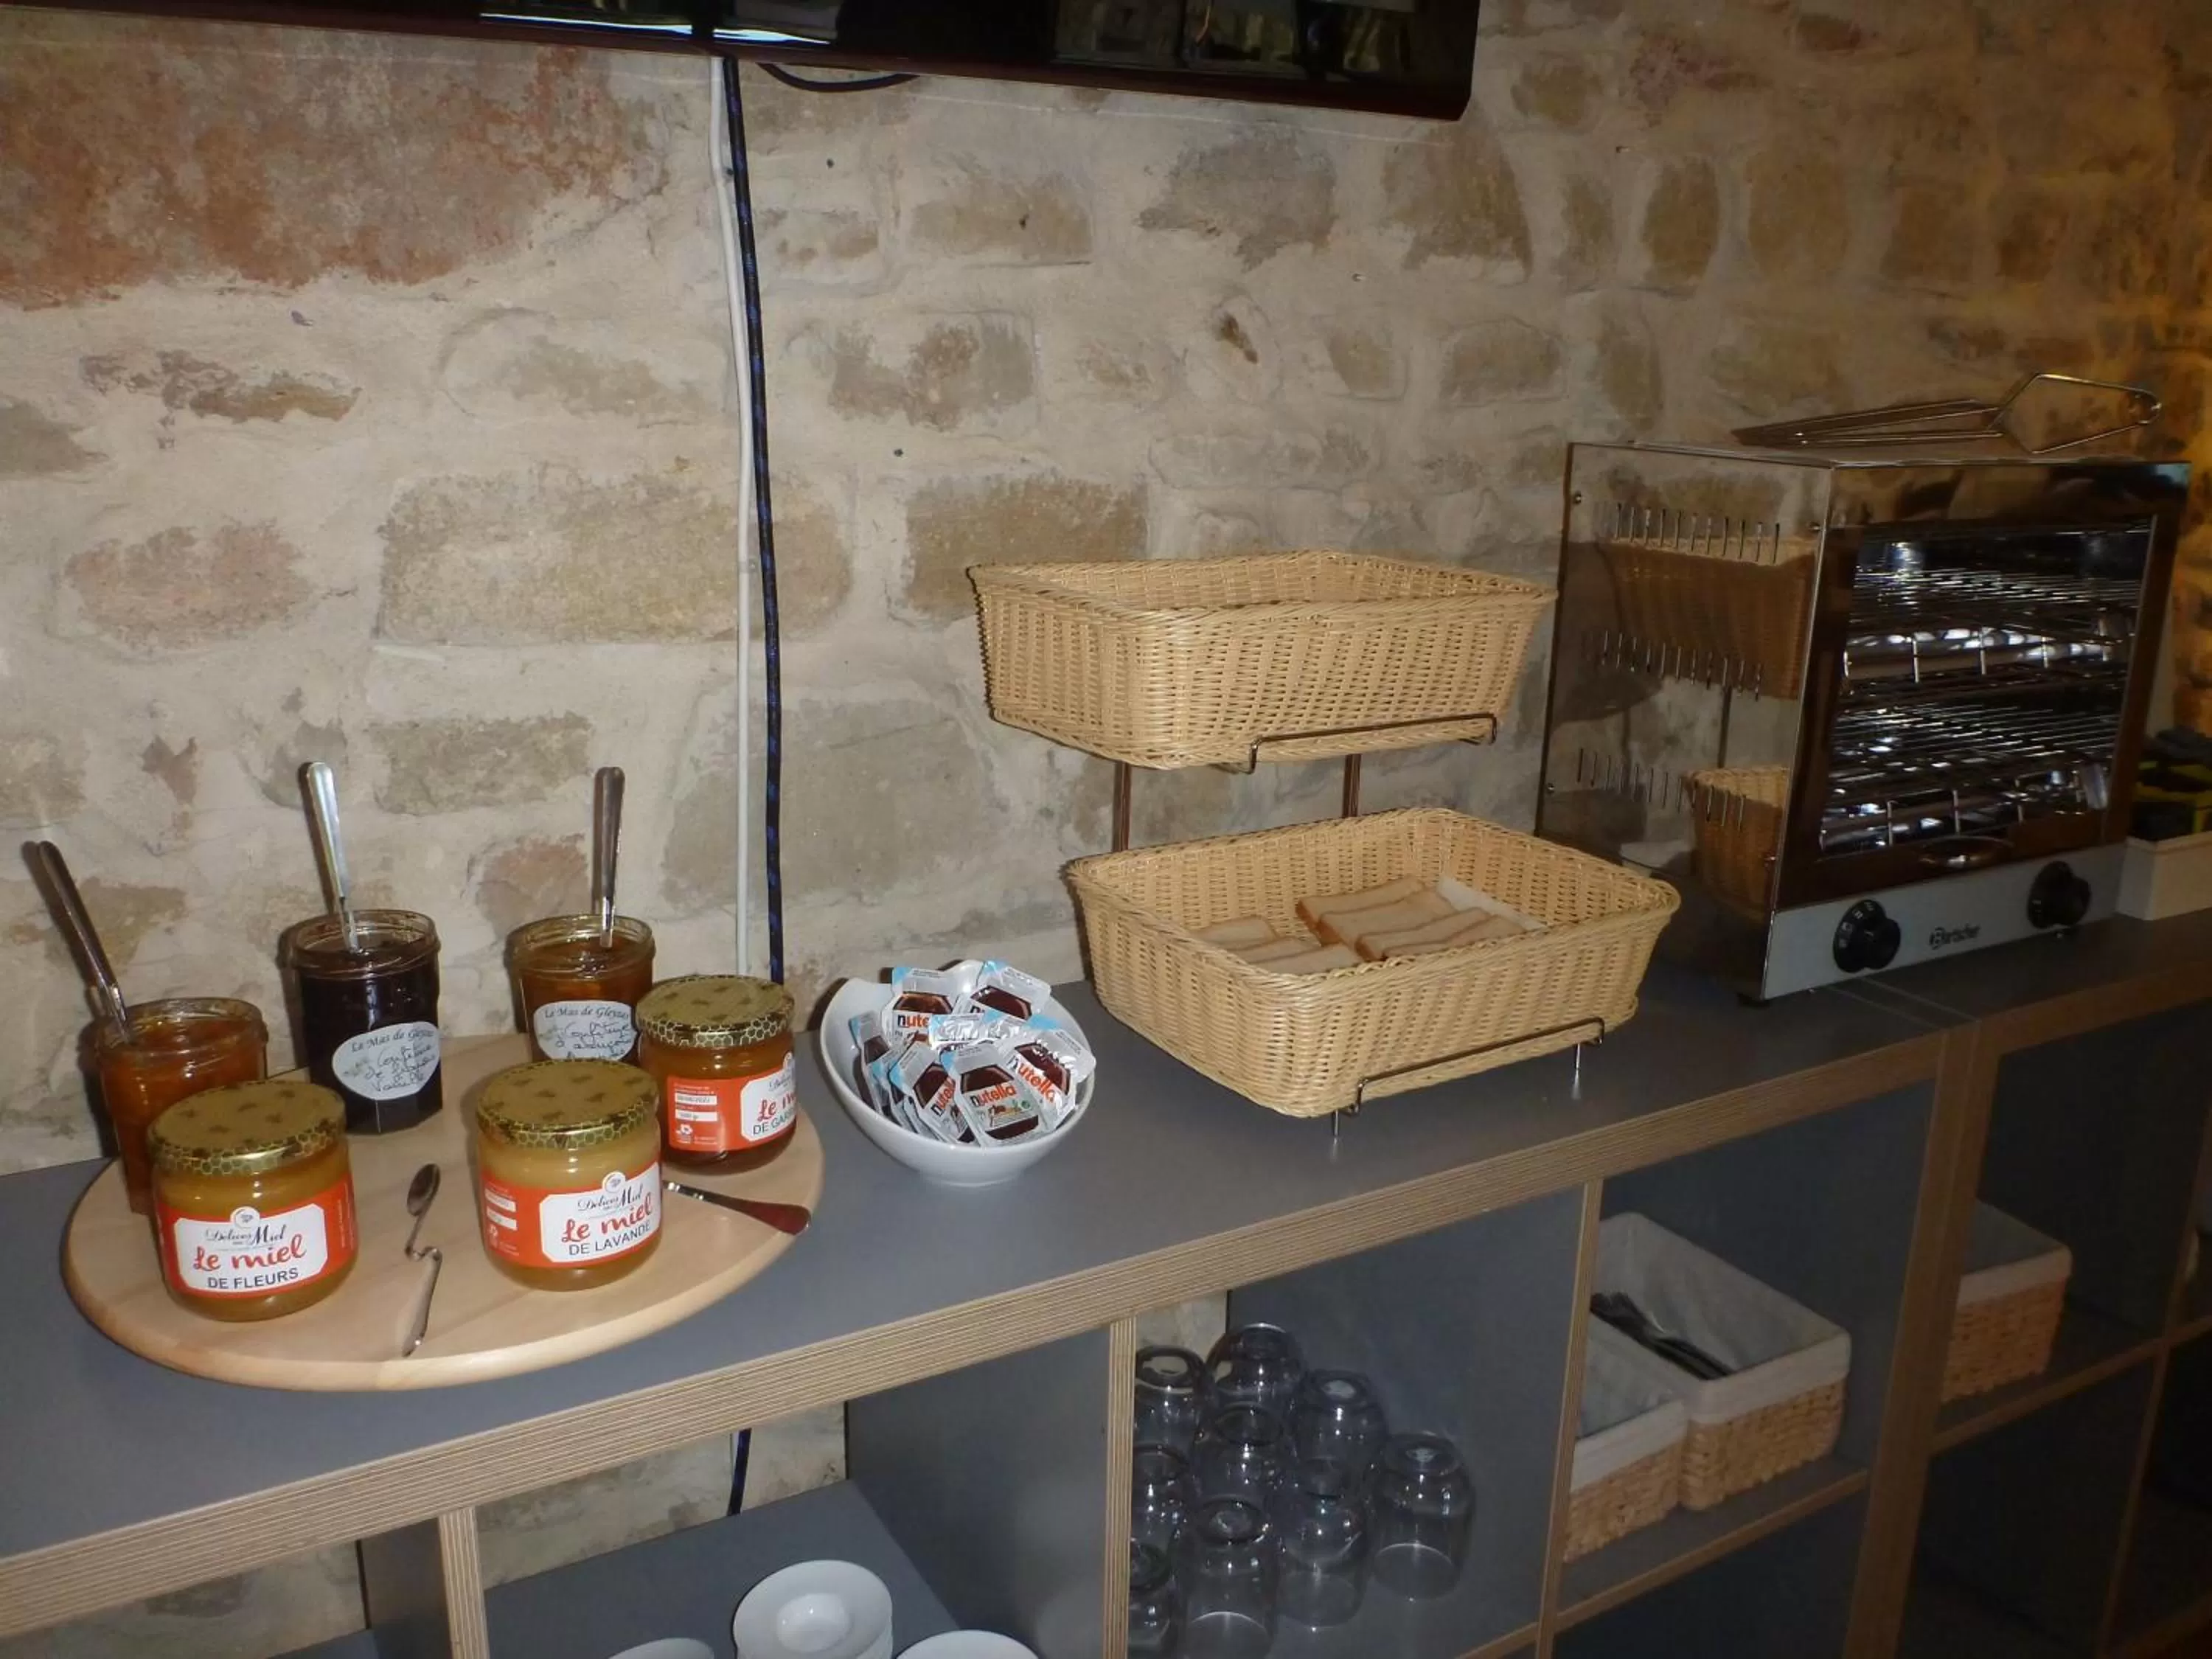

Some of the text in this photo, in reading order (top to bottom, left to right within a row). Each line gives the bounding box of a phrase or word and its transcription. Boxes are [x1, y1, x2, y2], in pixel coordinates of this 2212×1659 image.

[897, 1013, 929, 1028] nute
[931, 1076, 956, 1117] nutel
[970, 1085, 1017, 1107] nutella
[1006, 1055, 1055, 1103] nutella
[561, 1193, 653, 1243] Le miel
[192, 1234, 307, 1271] Le miel
[569, 1221, 651, 1256] DE LAVANDE
[207, 1267, 299, 1290] DE FLEURS
